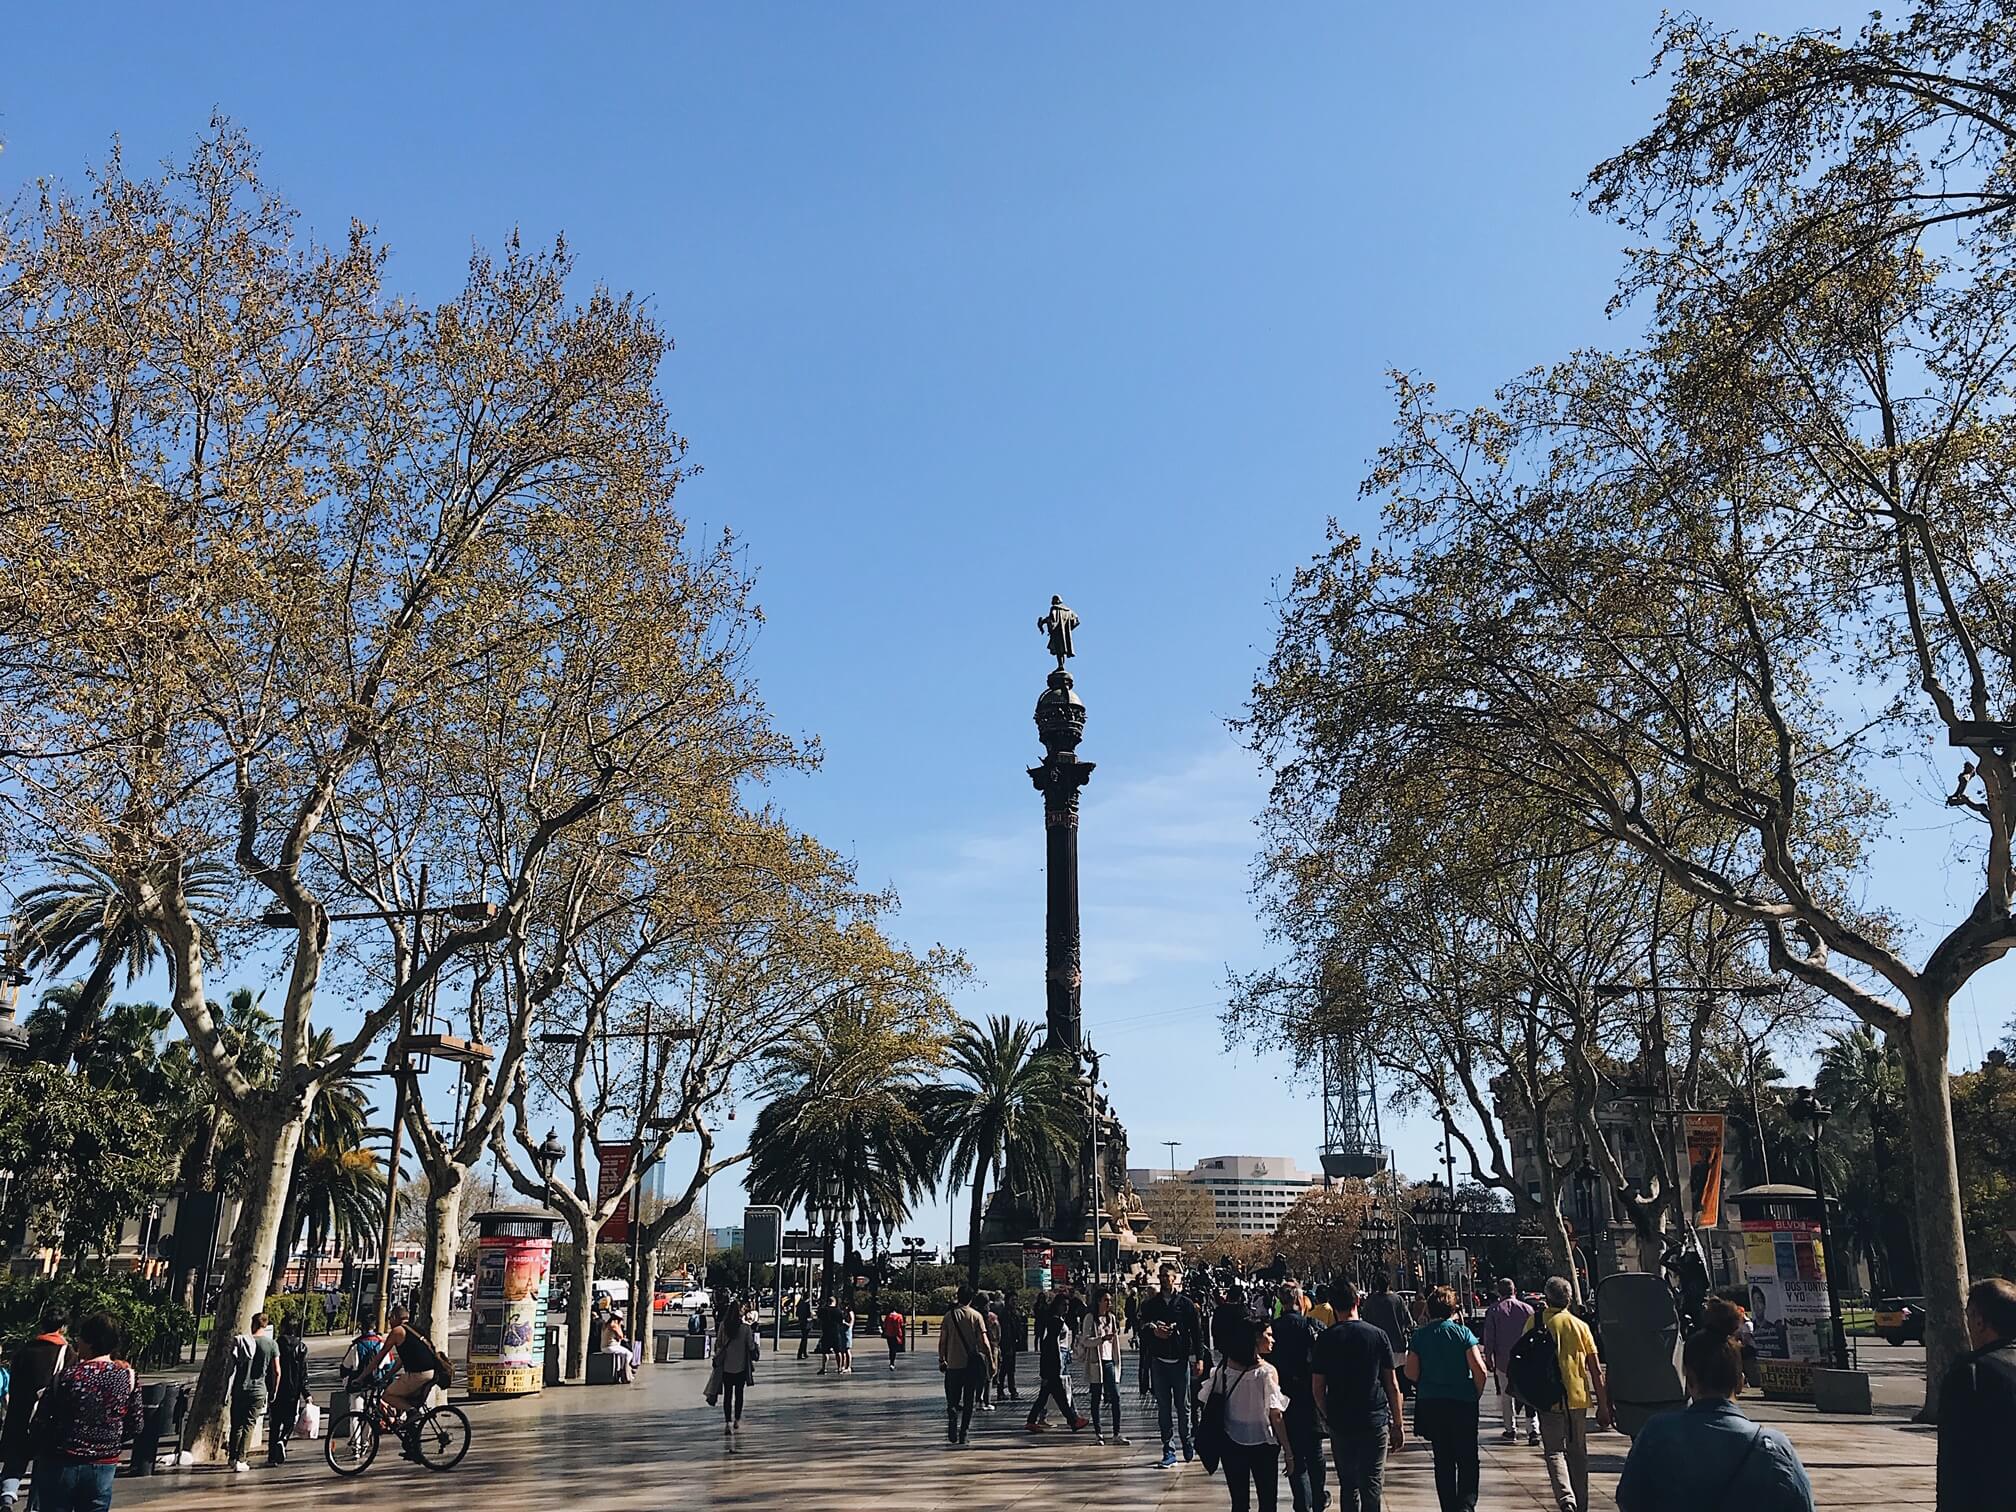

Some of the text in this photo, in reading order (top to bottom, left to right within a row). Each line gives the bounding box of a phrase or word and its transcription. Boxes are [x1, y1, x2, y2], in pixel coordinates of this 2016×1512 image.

[1775, 1220, 1800, 1229] BLVD
[1784, 1281, 1801, 1291] DOS
[1786, 1291, 1792, 1302] Y
[1794, 1291, 1805, 1302] YO
